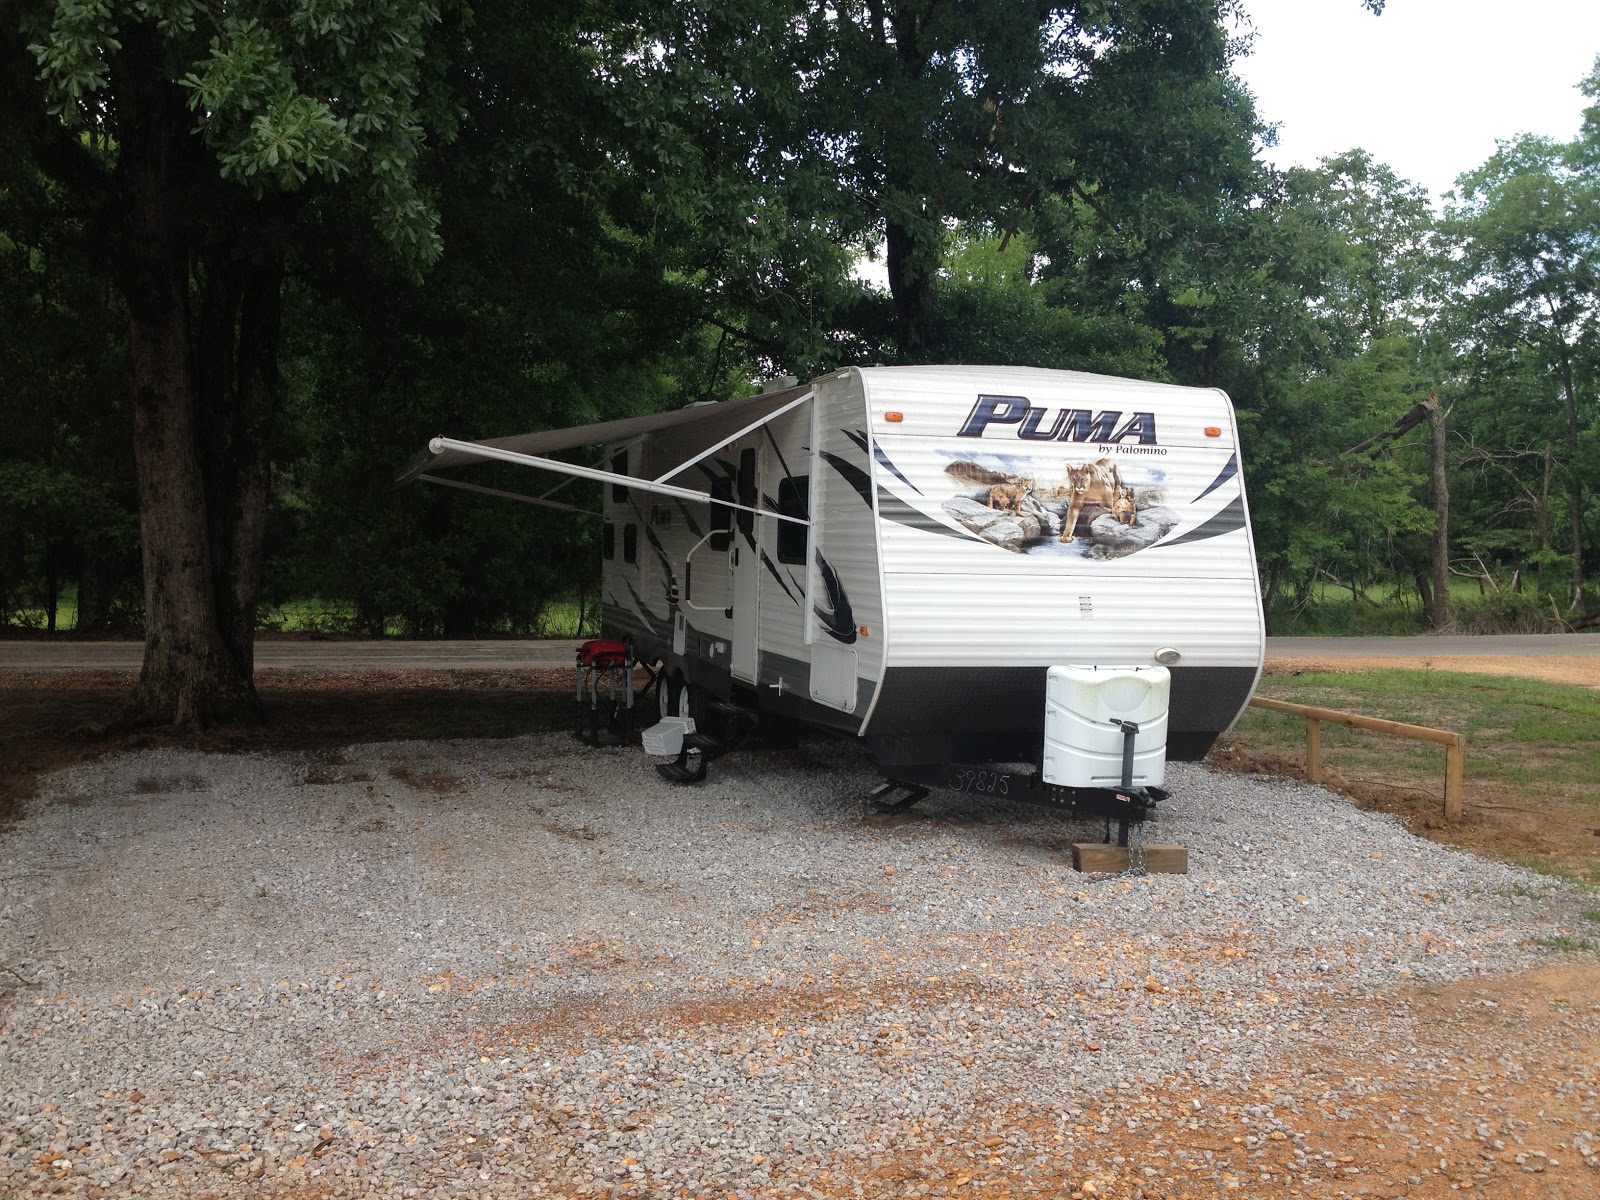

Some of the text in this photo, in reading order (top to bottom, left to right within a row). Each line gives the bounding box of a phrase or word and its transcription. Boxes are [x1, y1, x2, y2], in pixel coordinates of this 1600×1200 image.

[957, 394, 1158, 444] PUMA
[1098, 444, 1168, 456] by Palomino
[948, 768, 1010, 795] 39825
